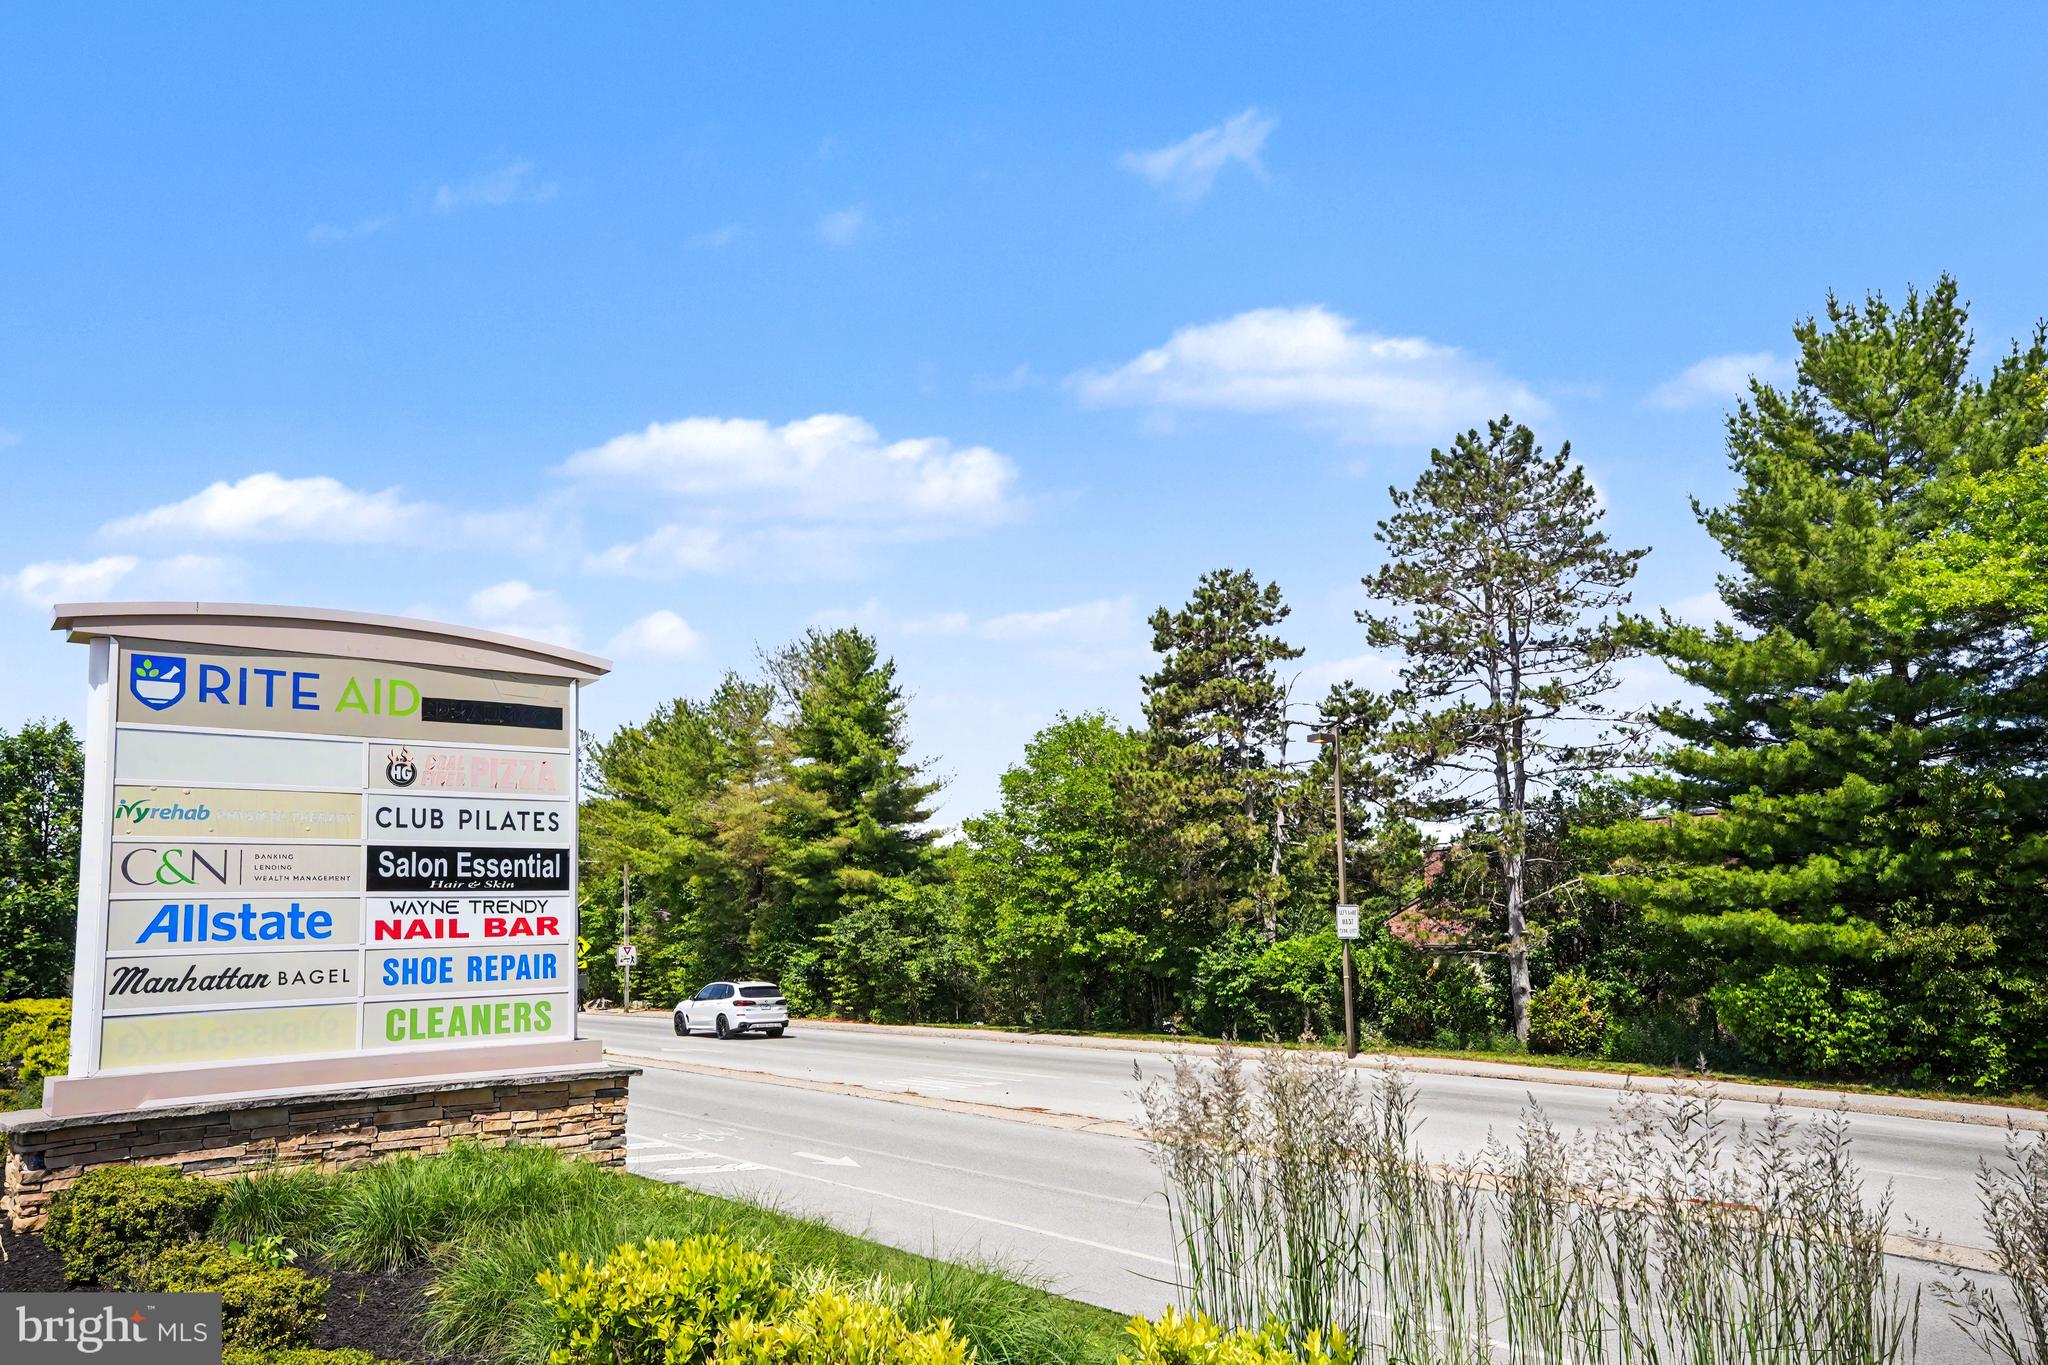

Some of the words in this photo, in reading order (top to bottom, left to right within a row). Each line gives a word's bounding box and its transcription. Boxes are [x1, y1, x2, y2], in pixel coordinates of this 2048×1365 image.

[198, 663, 320, 711] RITE
[335, 676, 421, 717] AID
[471, 757, 557, 791] PIZZA
[376, 806, 444, 830] CLUB
[459, 808, 560, 833] PILATES
[120, 848, 228, 886] C&N
[254, 853, 294, 861] BANKING
[378, 850, 448, 879] Salon
[456, 852, 561, 880] Essential
[254, 874, 290, 882] WEALTH
[429, 879, 465, 889] Hair
[483, 879, 515, 889] Skin
[389, 900, 459, 915] WAYNE
[470, 899, 549, 915] TRENDY
[135, 902, 333, 944] Allstate
[374, 917, 470, 941] NAIL
[483, 916, 559, 938] BAR
[108, 964, 272, 996] Manhattan
[278, 968, 350, 986] BAGEL
[382, 956, 453, 987] SHOE
[467, 953, 557, 982] REPAIR
[385, 1000, 552, 1043] CLEANERS
